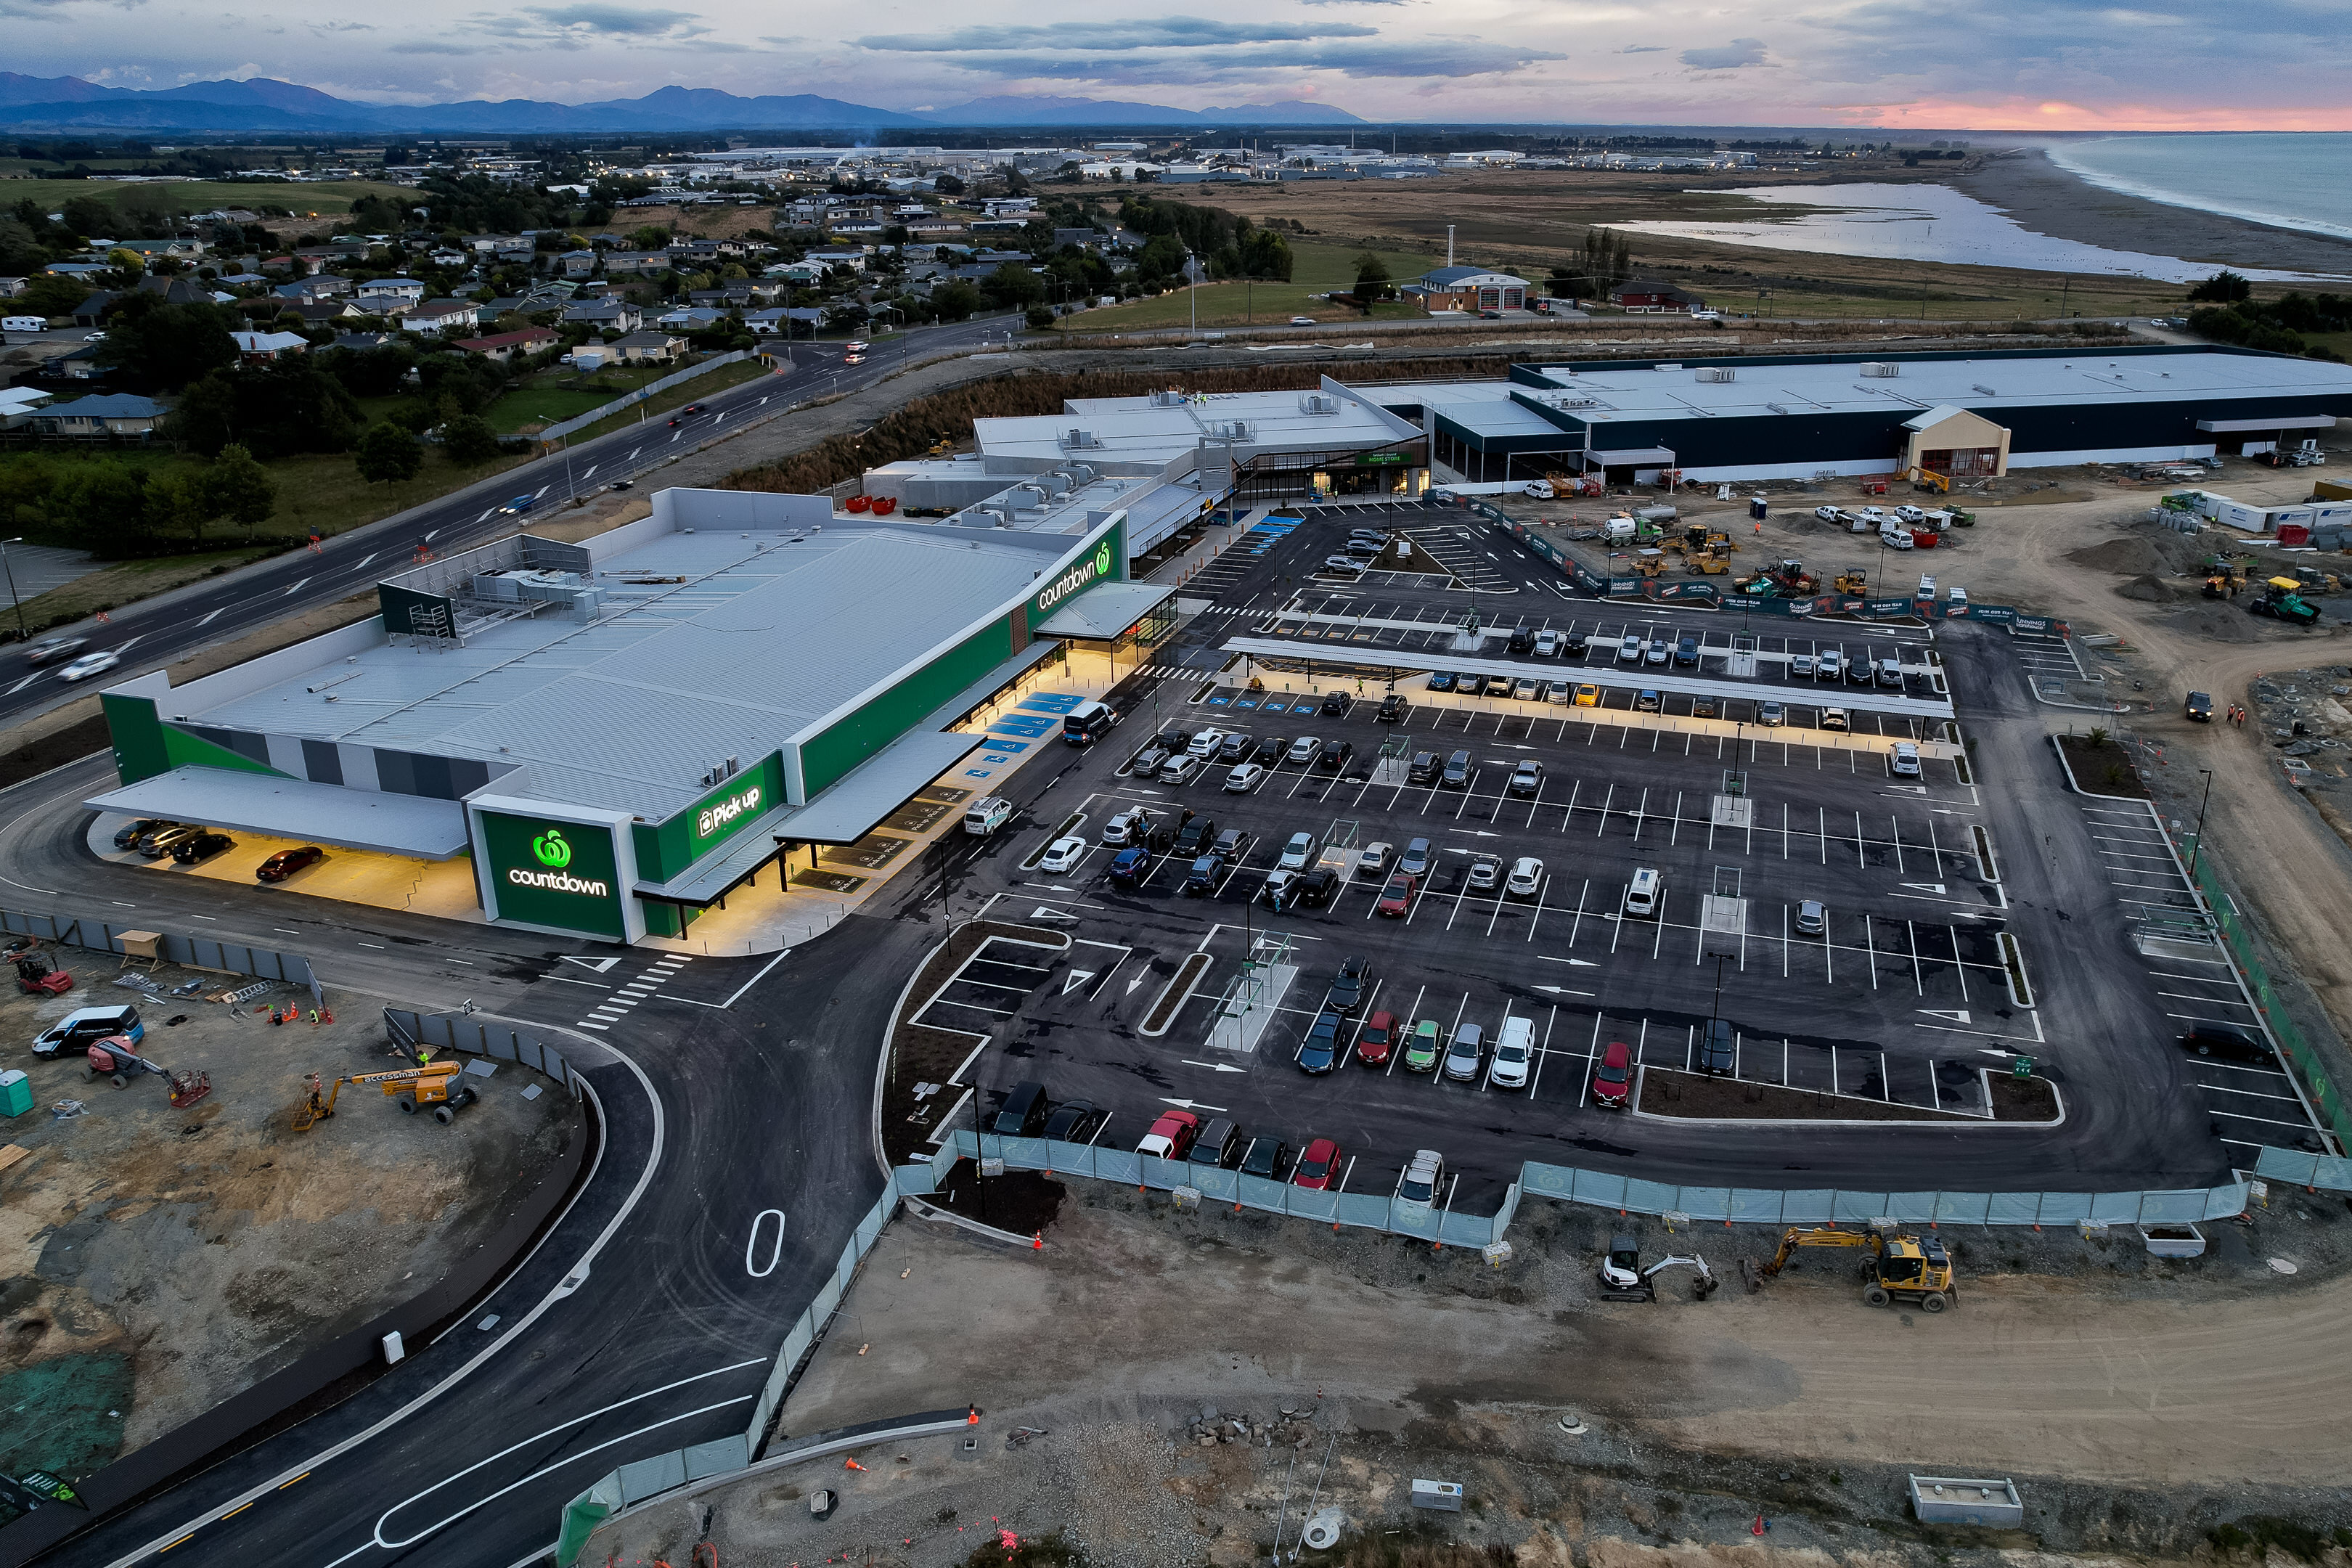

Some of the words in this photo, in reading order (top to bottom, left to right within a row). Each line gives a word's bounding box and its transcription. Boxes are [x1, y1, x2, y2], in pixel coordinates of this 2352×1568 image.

[1039, 561, 1095, 610] countdown
[713, 797, 741, 828] Pick
[742, 788, 759, 809] up
[867, 859, 881, 867] Pick
[509, 869, 607, 897] countdown
[837, 882, 852, 891] Pick
